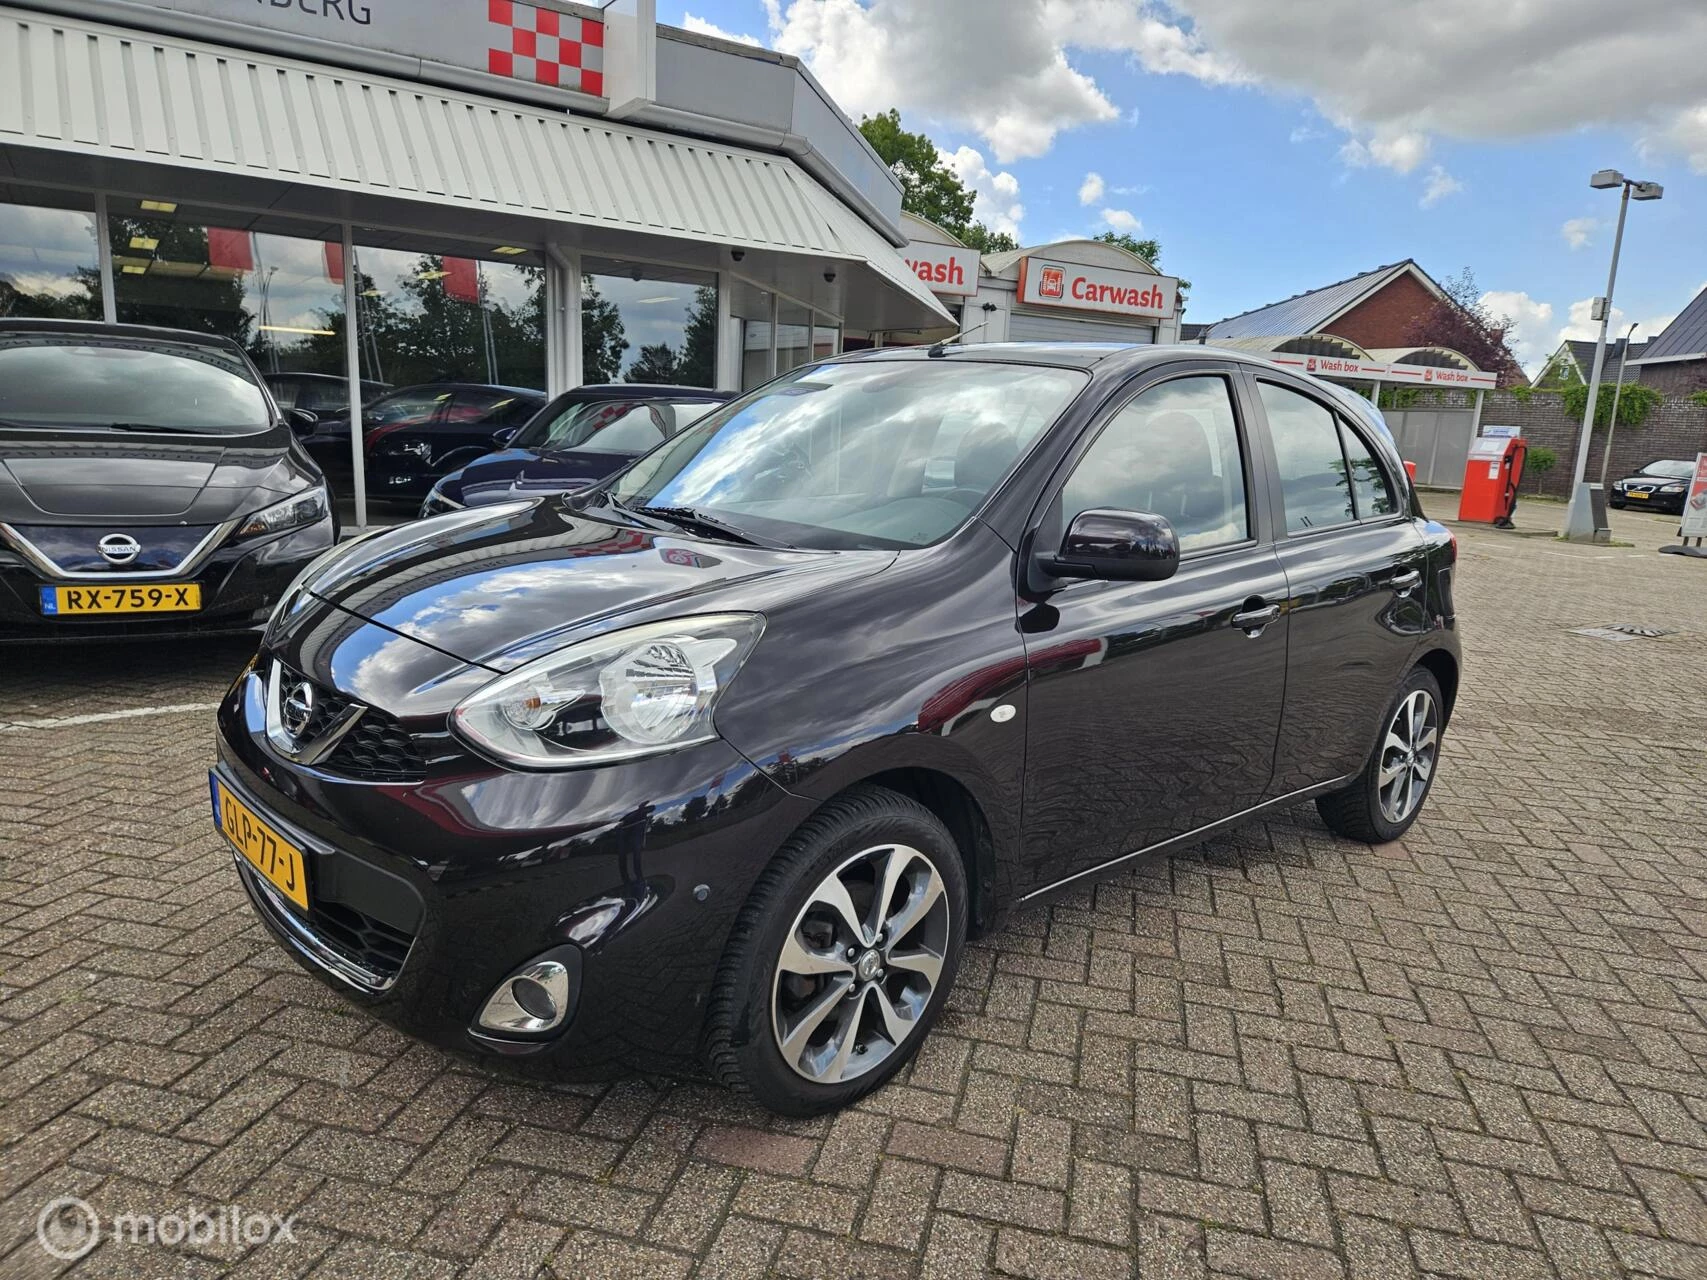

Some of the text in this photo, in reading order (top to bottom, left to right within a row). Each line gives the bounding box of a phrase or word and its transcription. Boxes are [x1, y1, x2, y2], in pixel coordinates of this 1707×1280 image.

[1071, 276, 1164, 309] Carwash
[1320, 359, 1359, 373] Wash box
[1436, 370, 1469, 382] Wash box
[44, 587, 189, 610] NL RX-759-X
[225, 796, 296, 892] GLP-77-J
